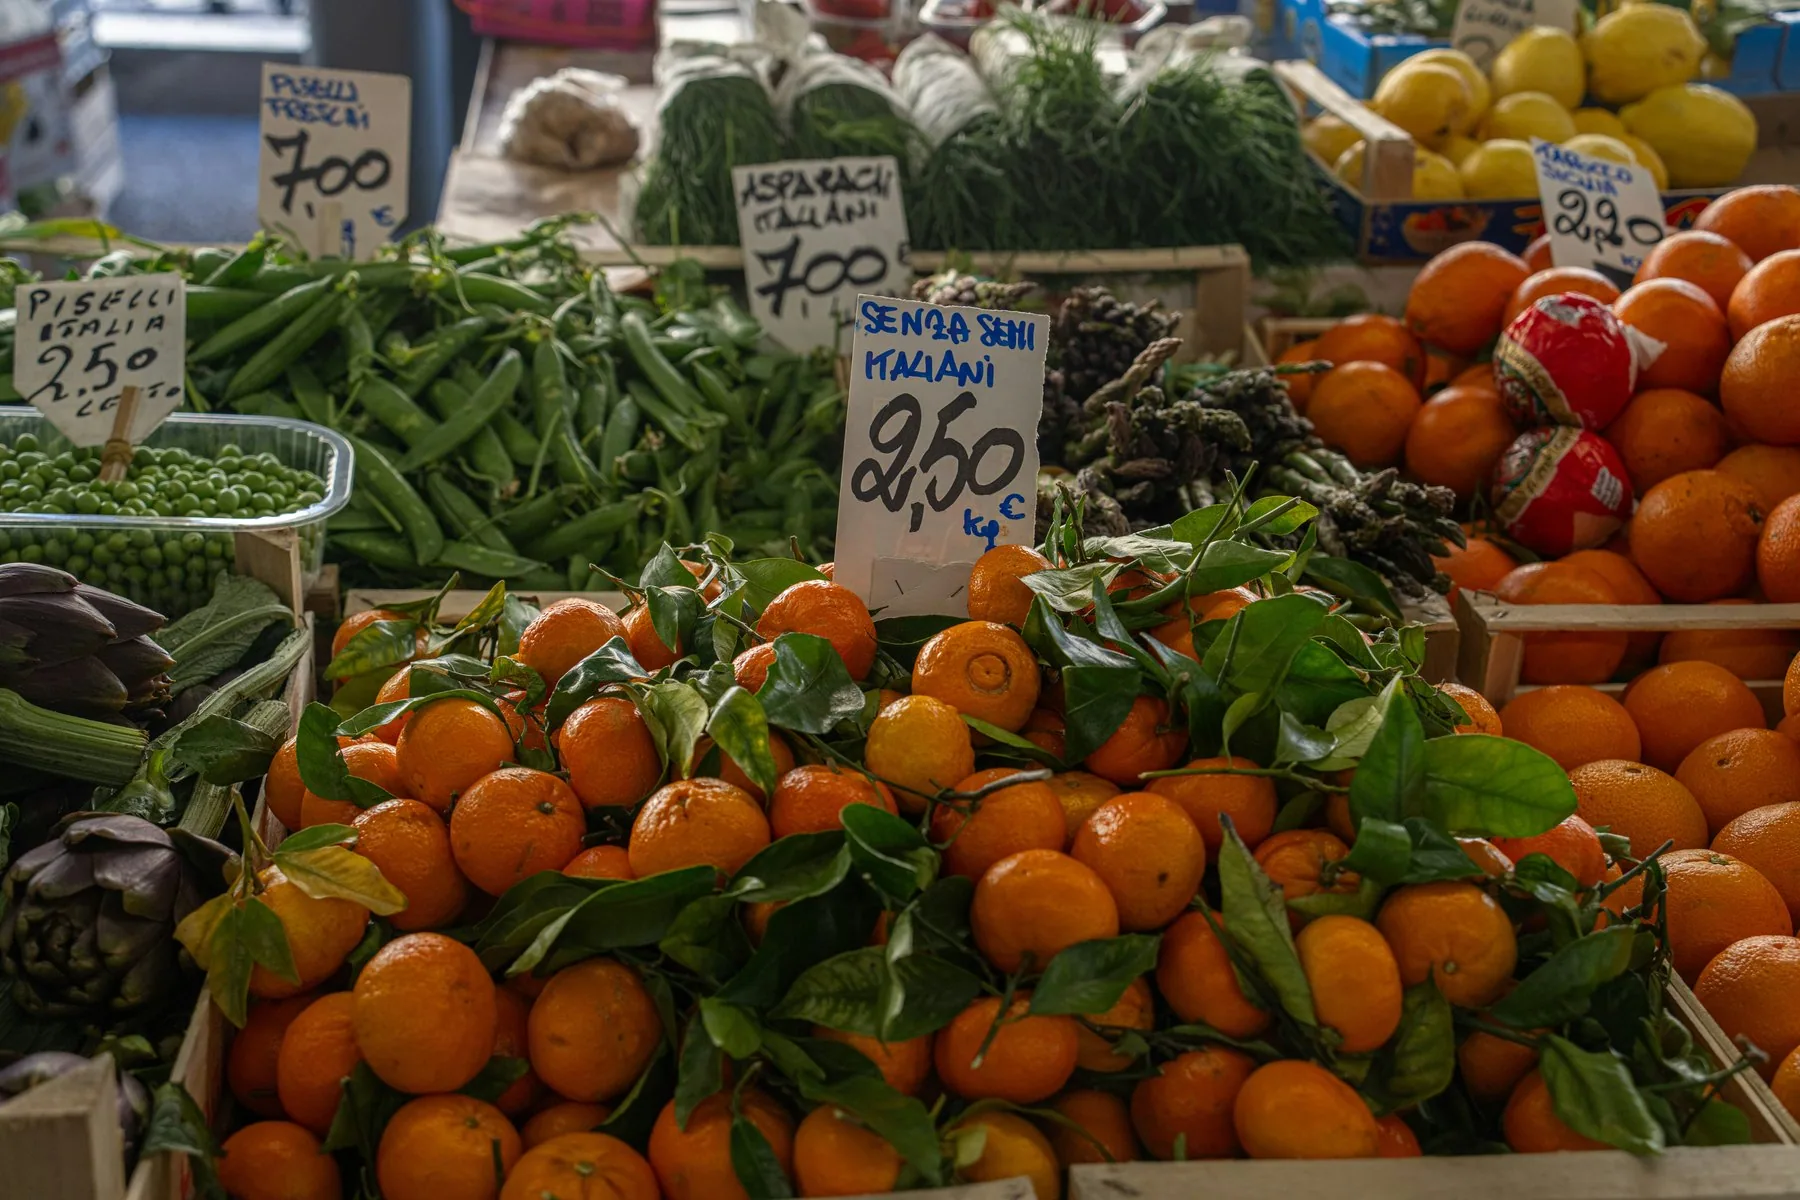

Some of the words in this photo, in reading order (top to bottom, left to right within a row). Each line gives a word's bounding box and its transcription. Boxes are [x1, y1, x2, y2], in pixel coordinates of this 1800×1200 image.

[29, 289, 175, 321] PISELLI
[40, 315, 166, 342] ITALIA
[861, 301, 971, 344] SENZA
[977, 313, 1035, 351] SEMI
[865, 349, 995, 388] ITALIANI
[851, 391, 1025, 533] 2,50
[999, 493, 1026, 520] €
